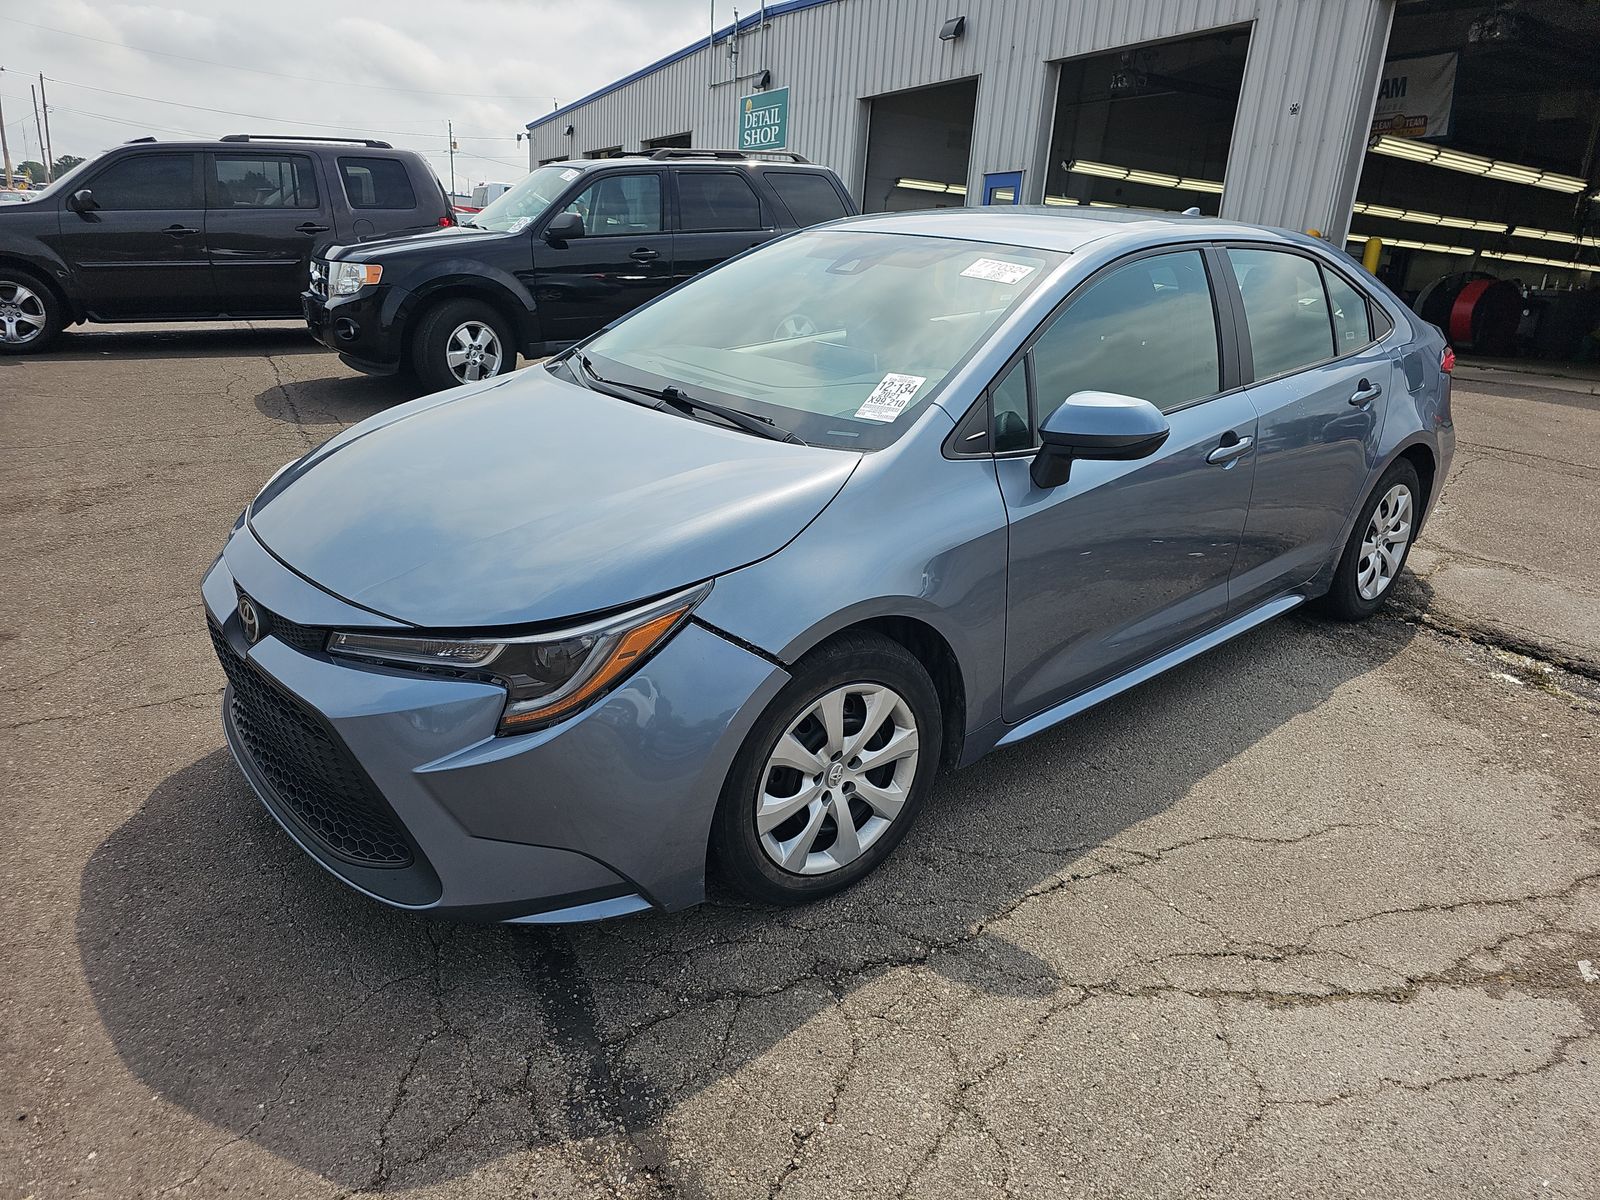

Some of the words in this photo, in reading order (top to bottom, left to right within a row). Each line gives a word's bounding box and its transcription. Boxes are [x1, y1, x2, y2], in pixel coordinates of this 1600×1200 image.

[745, 108, 781, 129] DETAIL
[1405, 116, 1425, 128] TEAM
[743, 125, 779, 146] SHOP
